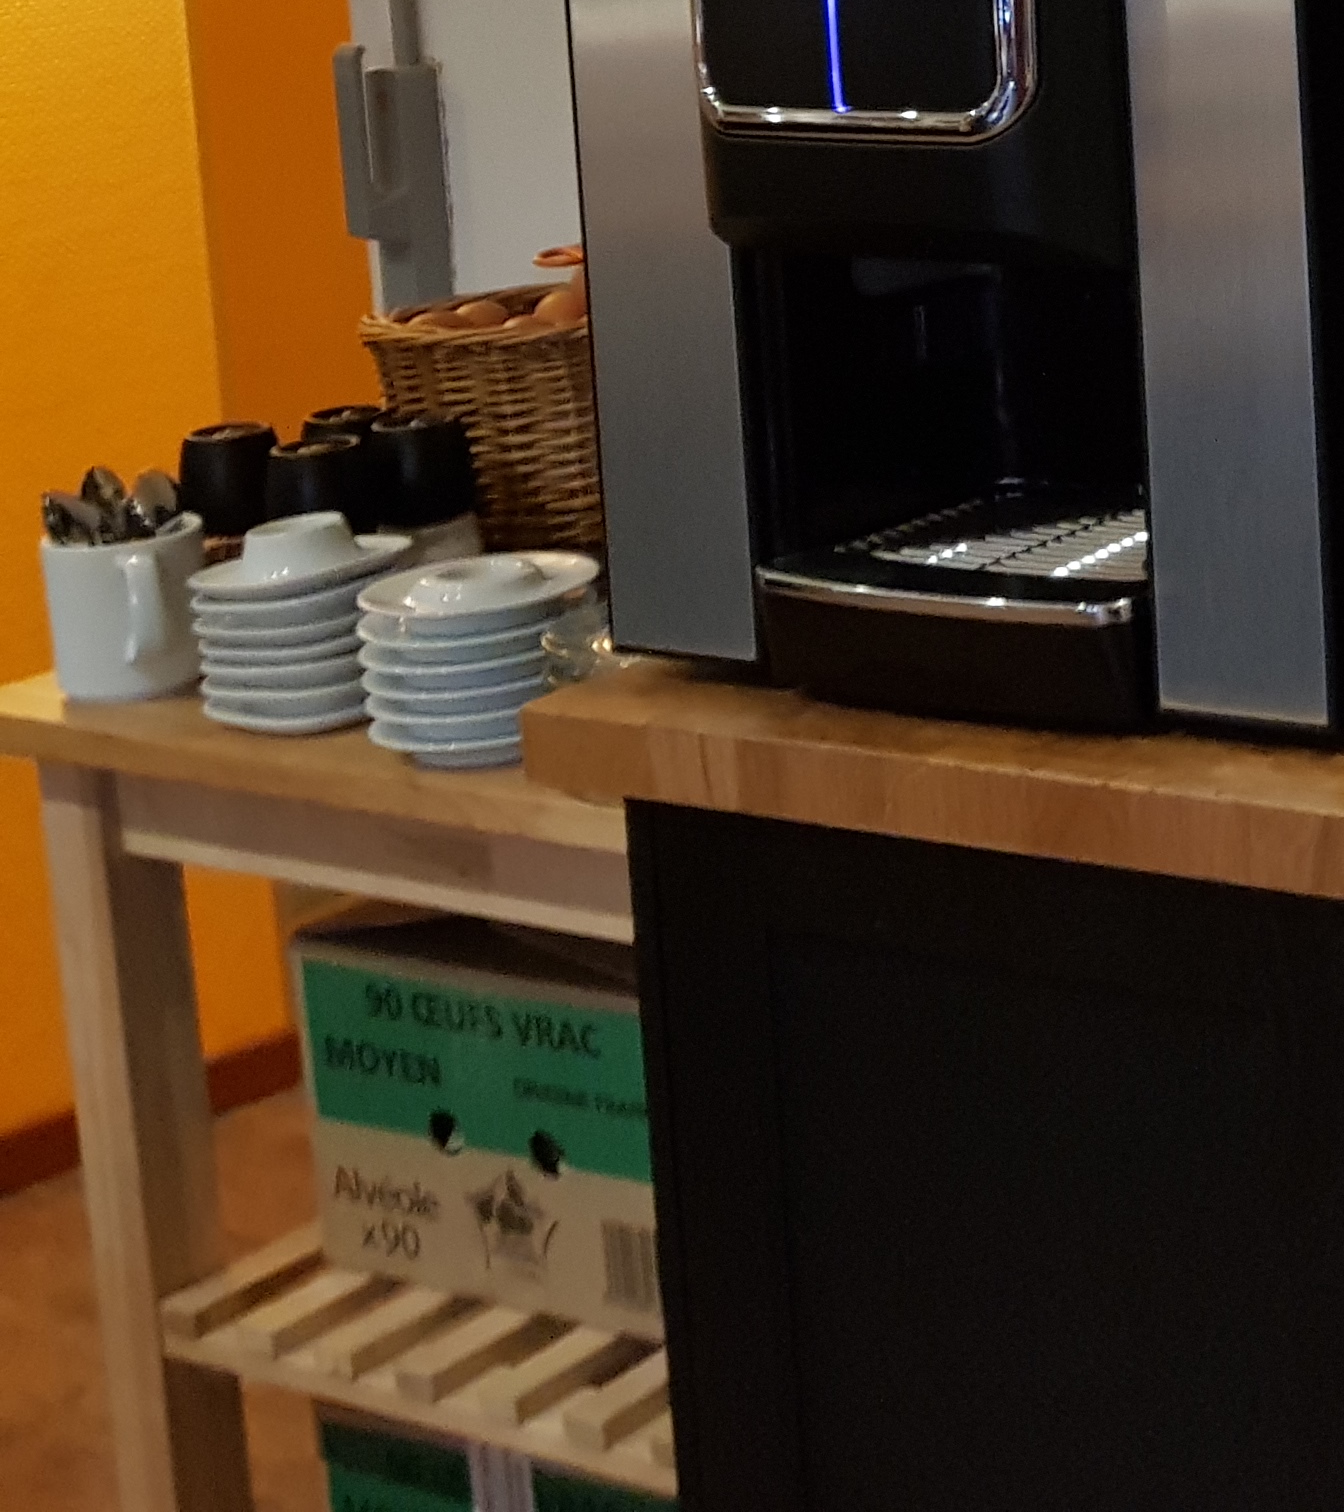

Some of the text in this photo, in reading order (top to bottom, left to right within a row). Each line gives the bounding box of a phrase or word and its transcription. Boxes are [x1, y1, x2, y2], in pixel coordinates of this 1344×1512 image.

[365, 982, 403, 1021] 90
[511, 1011, 602, 1059] VRAC
[323, 1034, 441, 1088] MOYEN
